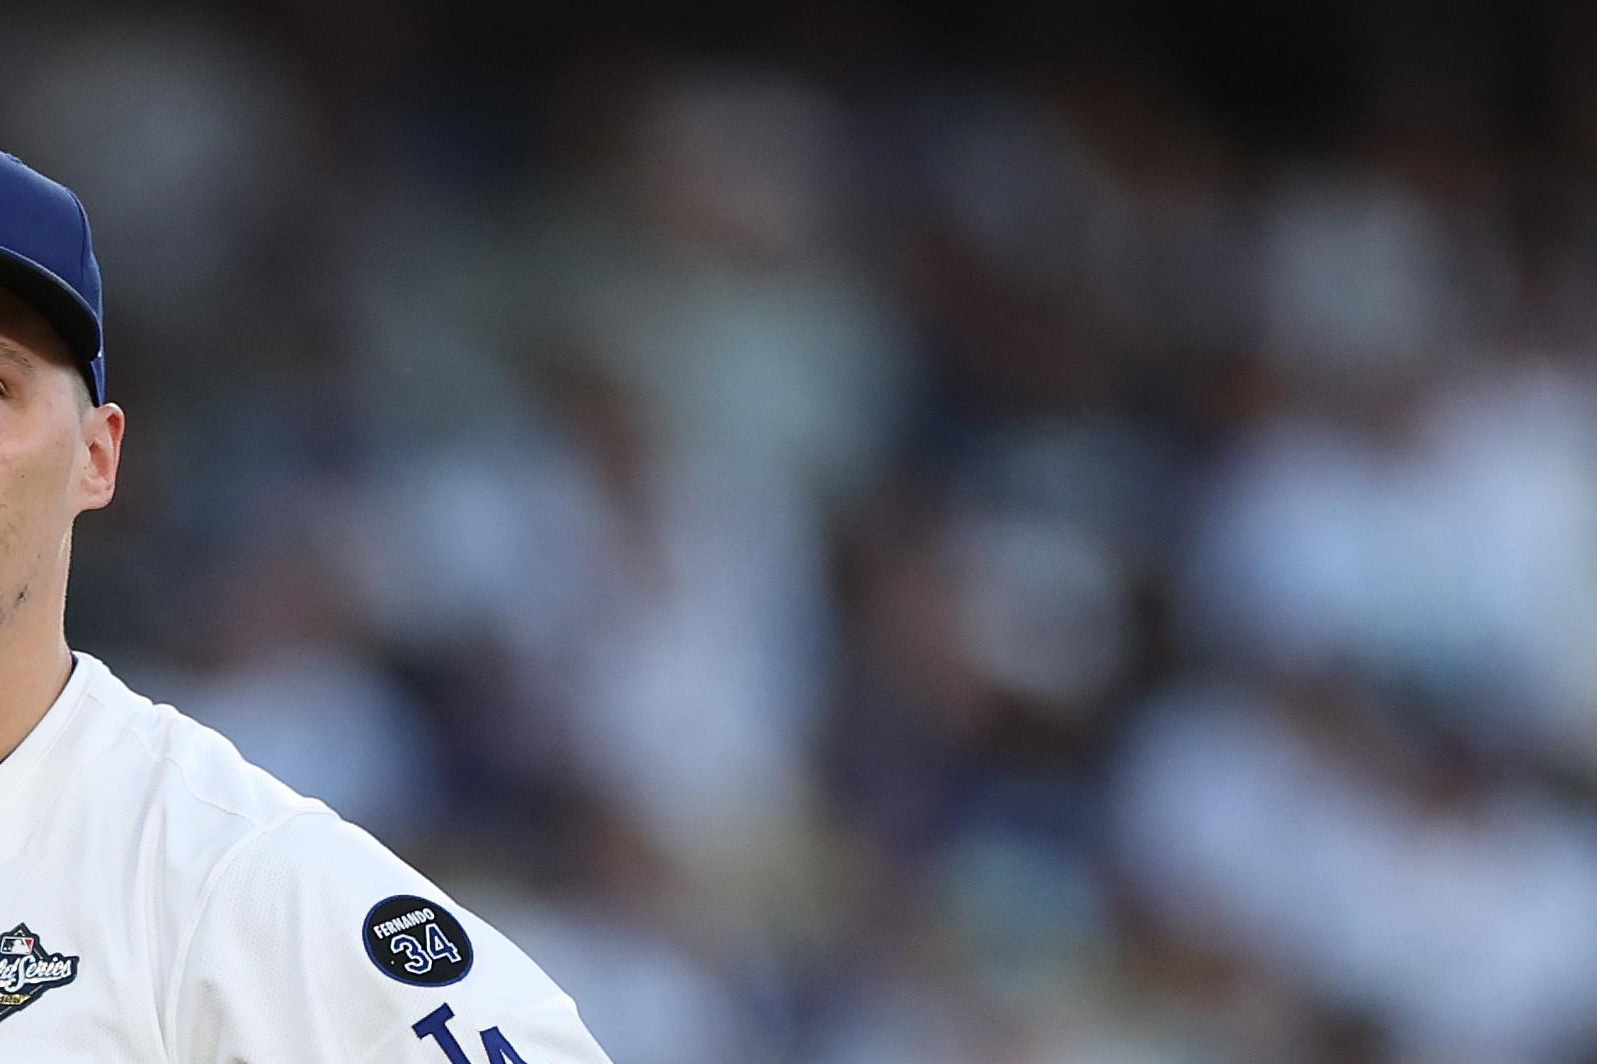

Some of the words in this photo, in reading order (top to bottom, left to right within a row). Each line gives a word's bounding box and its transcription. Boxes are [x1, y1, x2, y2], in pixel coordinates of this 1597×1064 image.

[373, 907, 435, 939] FERNANDO
[390, 922, 461, 975] 34
[4, 955, 72, 993] Series
